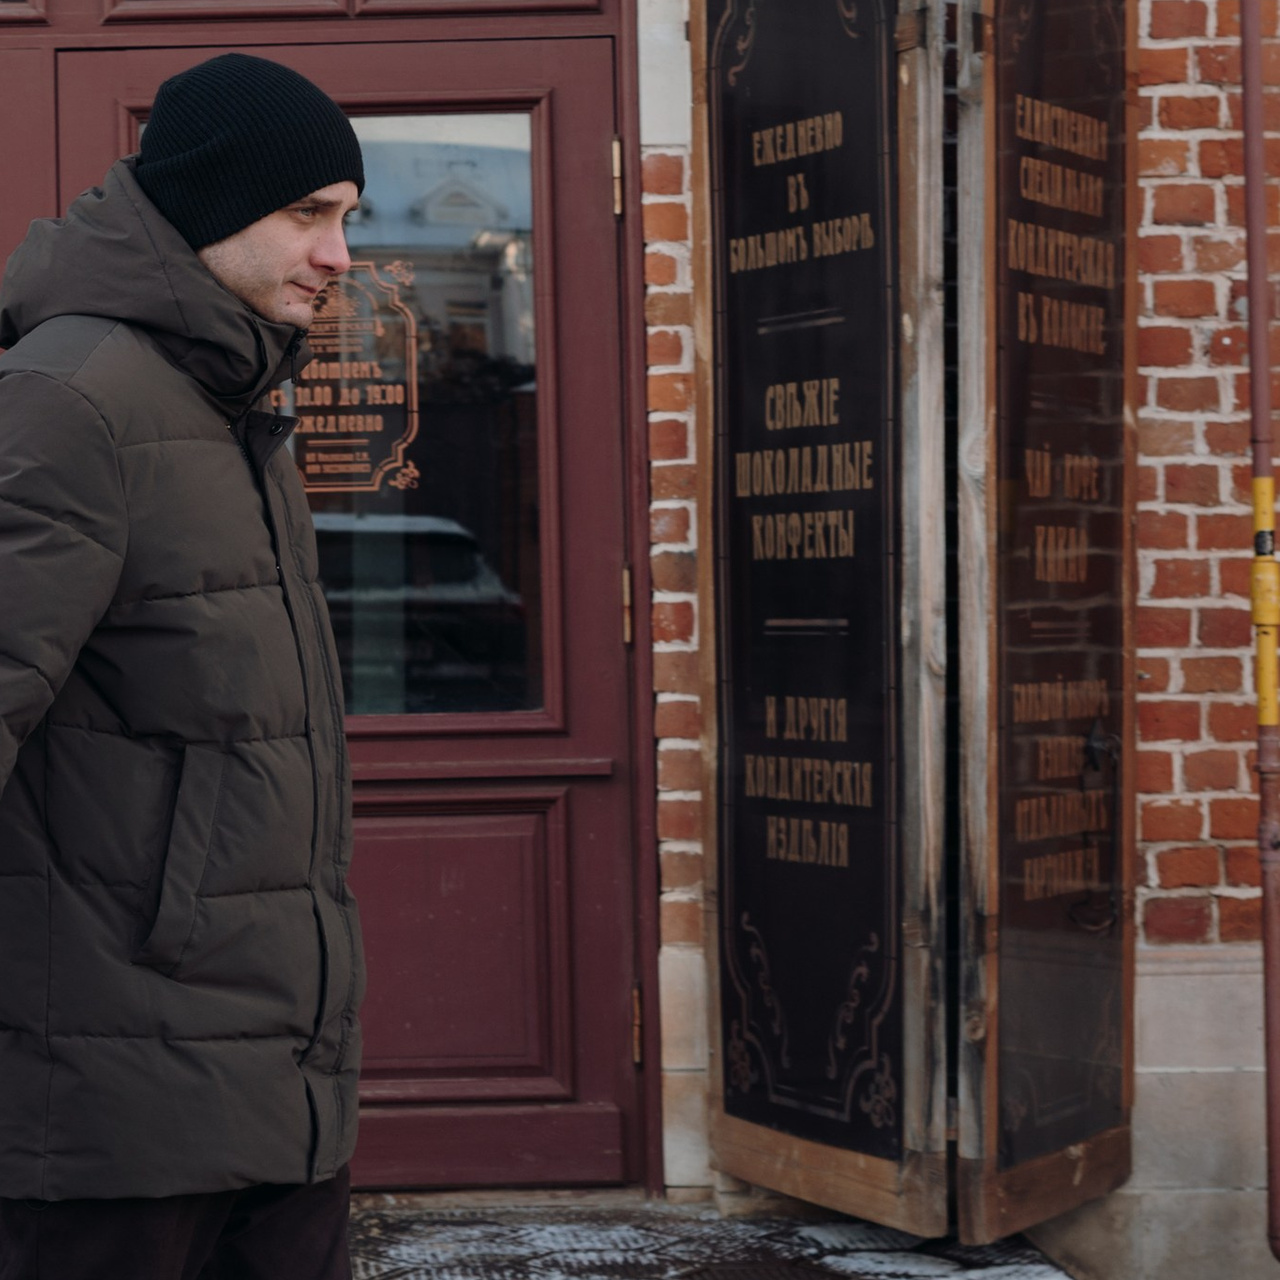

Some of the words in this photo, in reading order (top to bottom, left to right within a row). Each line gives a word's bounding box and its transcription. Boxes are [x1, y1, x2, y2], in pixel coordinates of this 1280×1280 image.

[751, 110, 844, 167] ЕЖЕДНЕВНО
[787, 172, 810, 214] ВЪ
[729, 225, 808, 274] БОЛЬШОМЪ
[300, 359, 382, 379] аботаемъ
[735, 439, 874, 498] ШОКОЛАДНЫЕ
[751, 508, 855, 561] КОНФЕКТЫ
